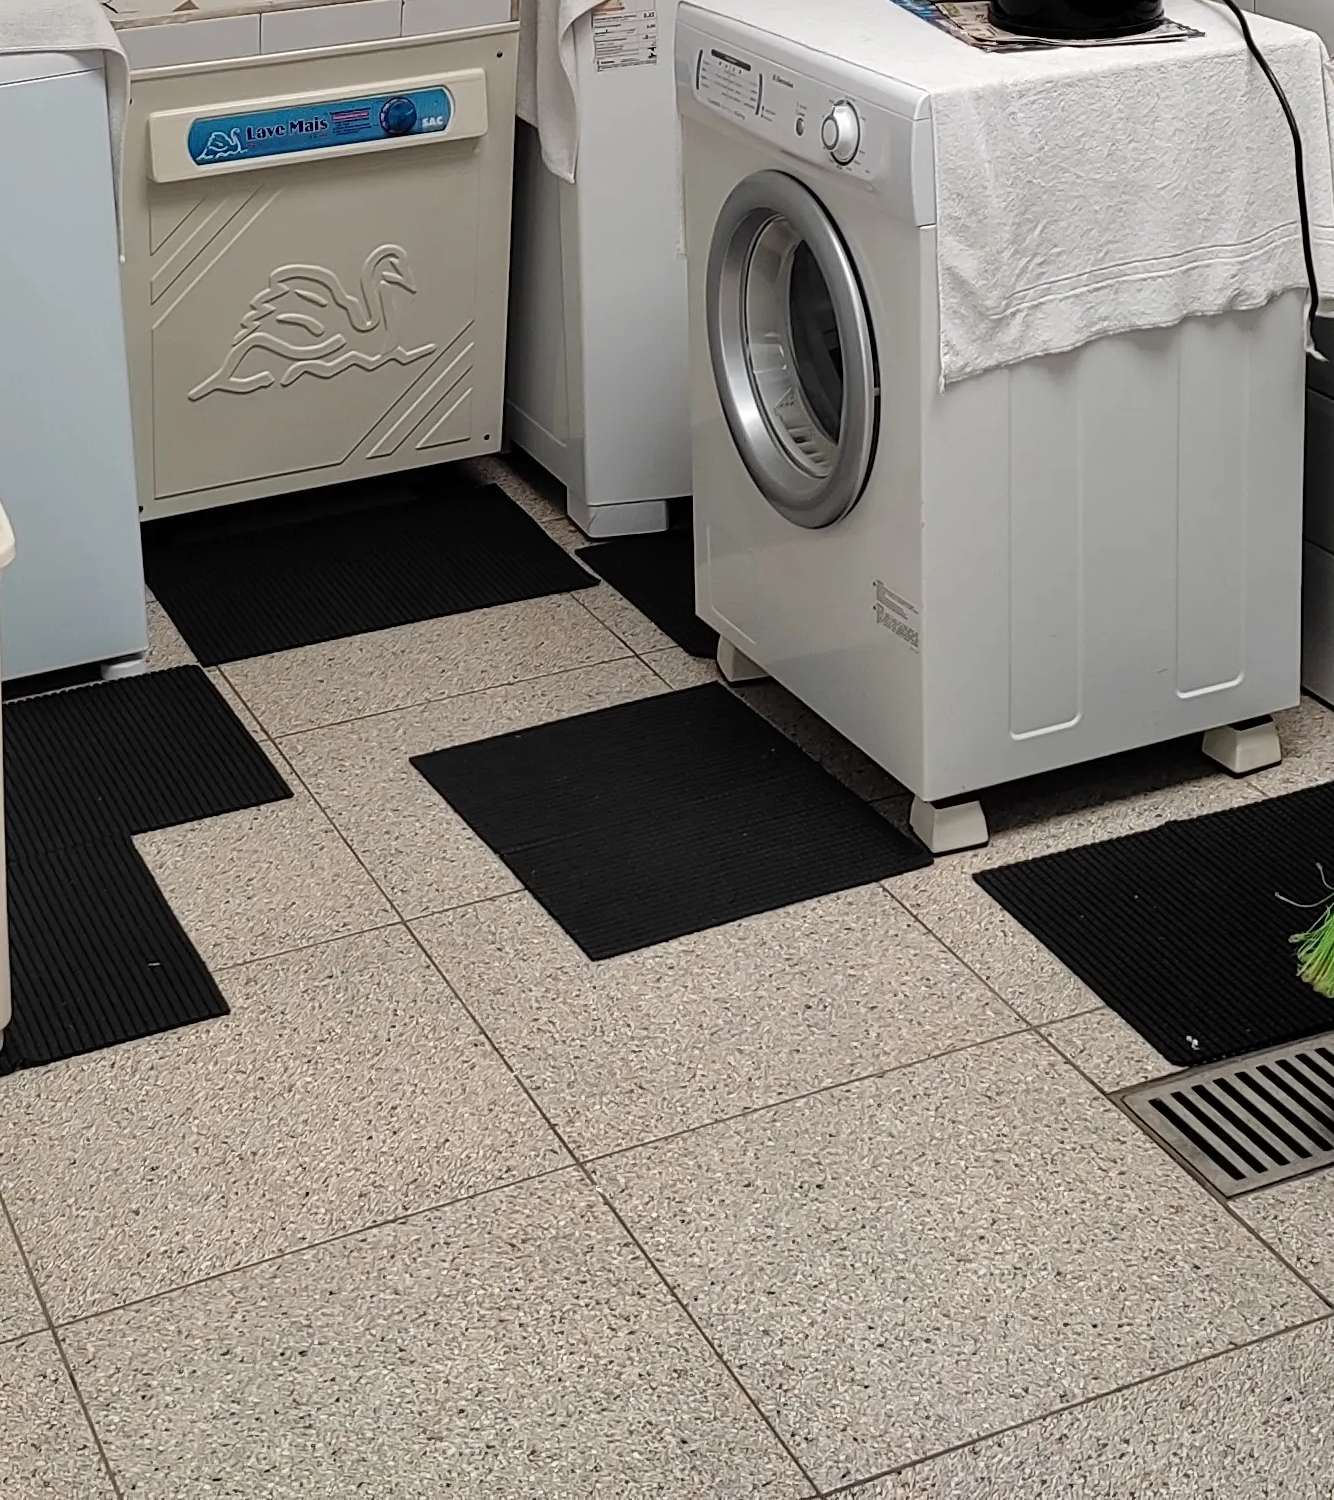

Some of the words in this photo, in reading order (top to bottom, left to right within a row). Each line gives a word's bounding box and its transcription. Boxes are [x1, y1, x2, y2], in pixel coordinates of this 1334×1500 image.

[245, 124, 285, 141] Lave
[289, 116, 328, 134] Mais
[421, 115, 444, 128] SAC
